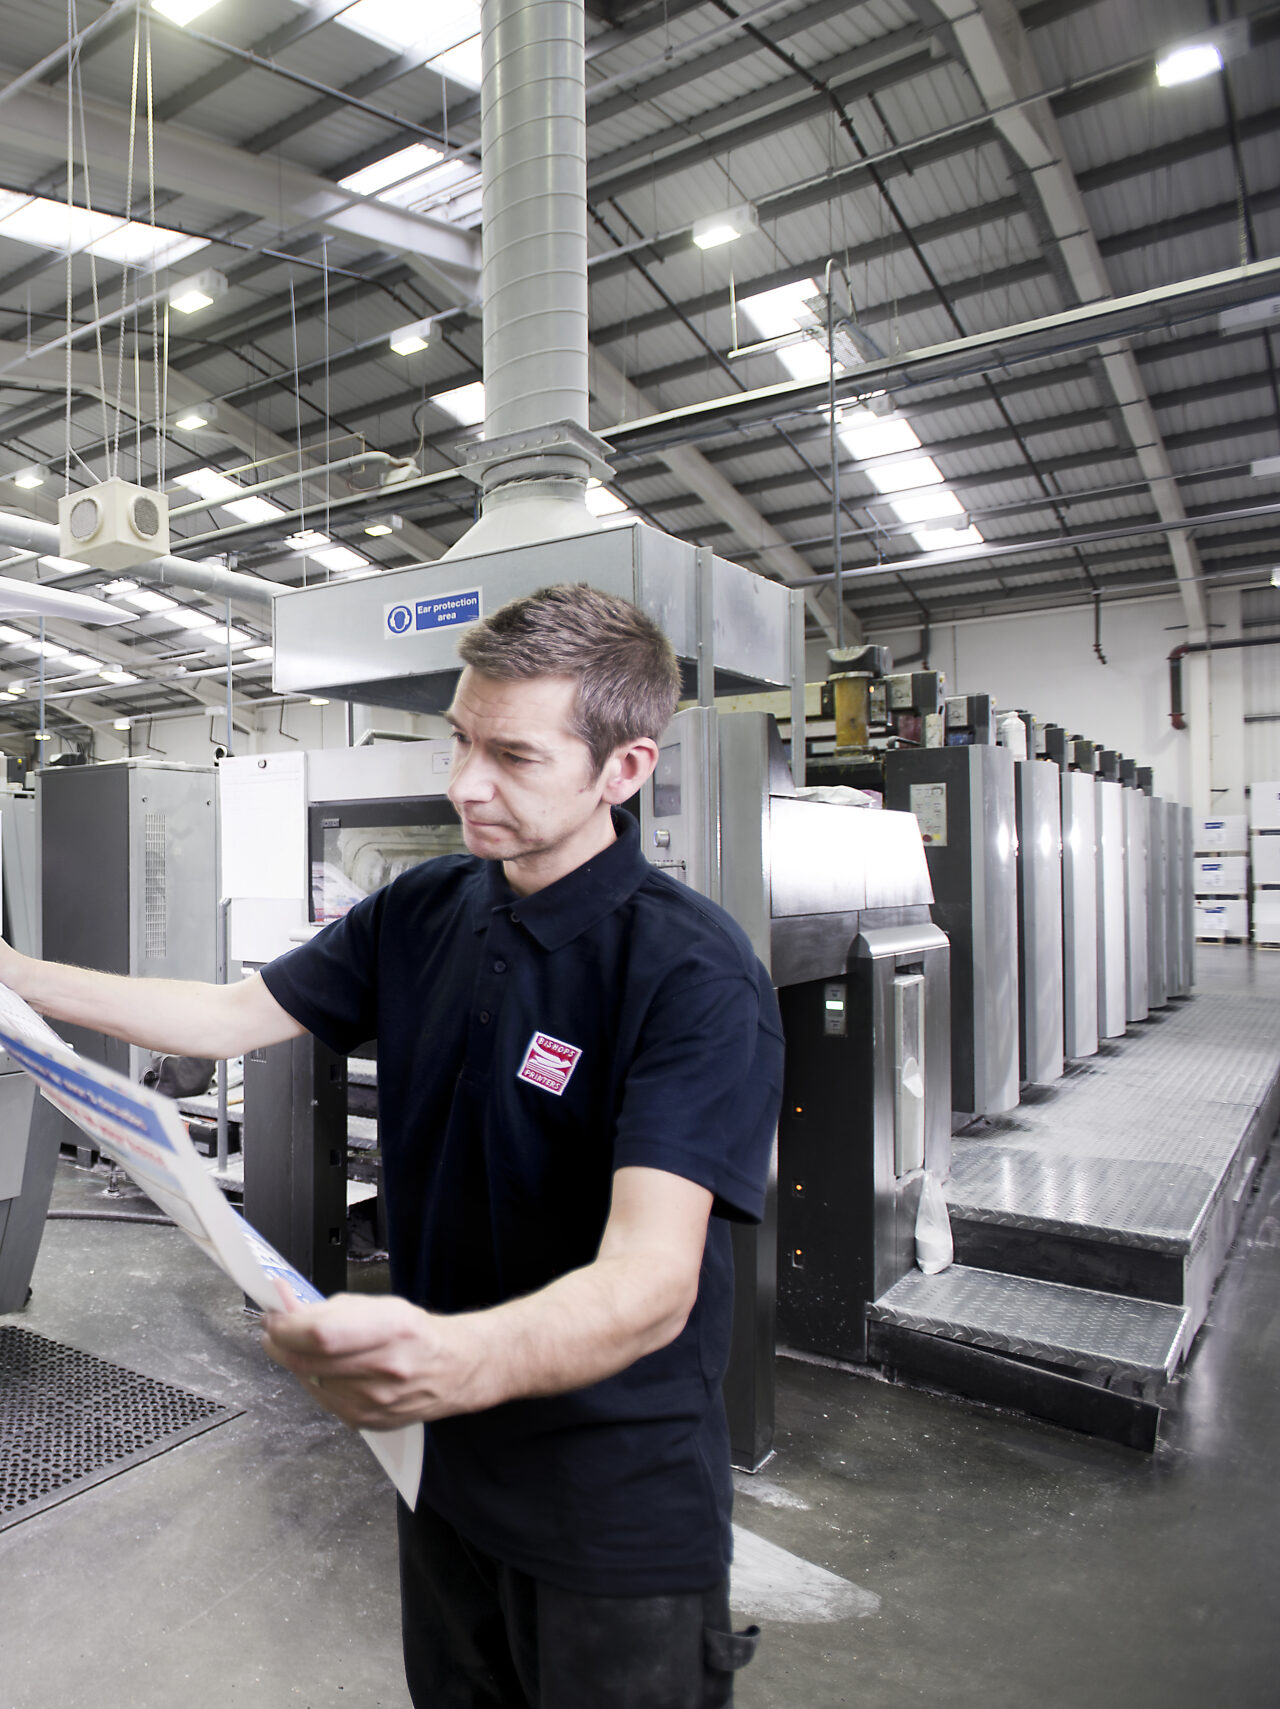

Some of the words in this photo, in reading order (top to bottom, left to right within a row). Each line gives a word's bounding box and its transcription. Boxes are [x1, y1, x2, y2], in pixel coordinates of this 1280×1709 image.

[417, 605, 431, 614] Ear
[433, 597, 477, 613] protection
[437, 612, 456, 621] area
[538, 1037, 576, 1058] BISHOPS
[524, 1069, 561, 1090] PRINTERS
